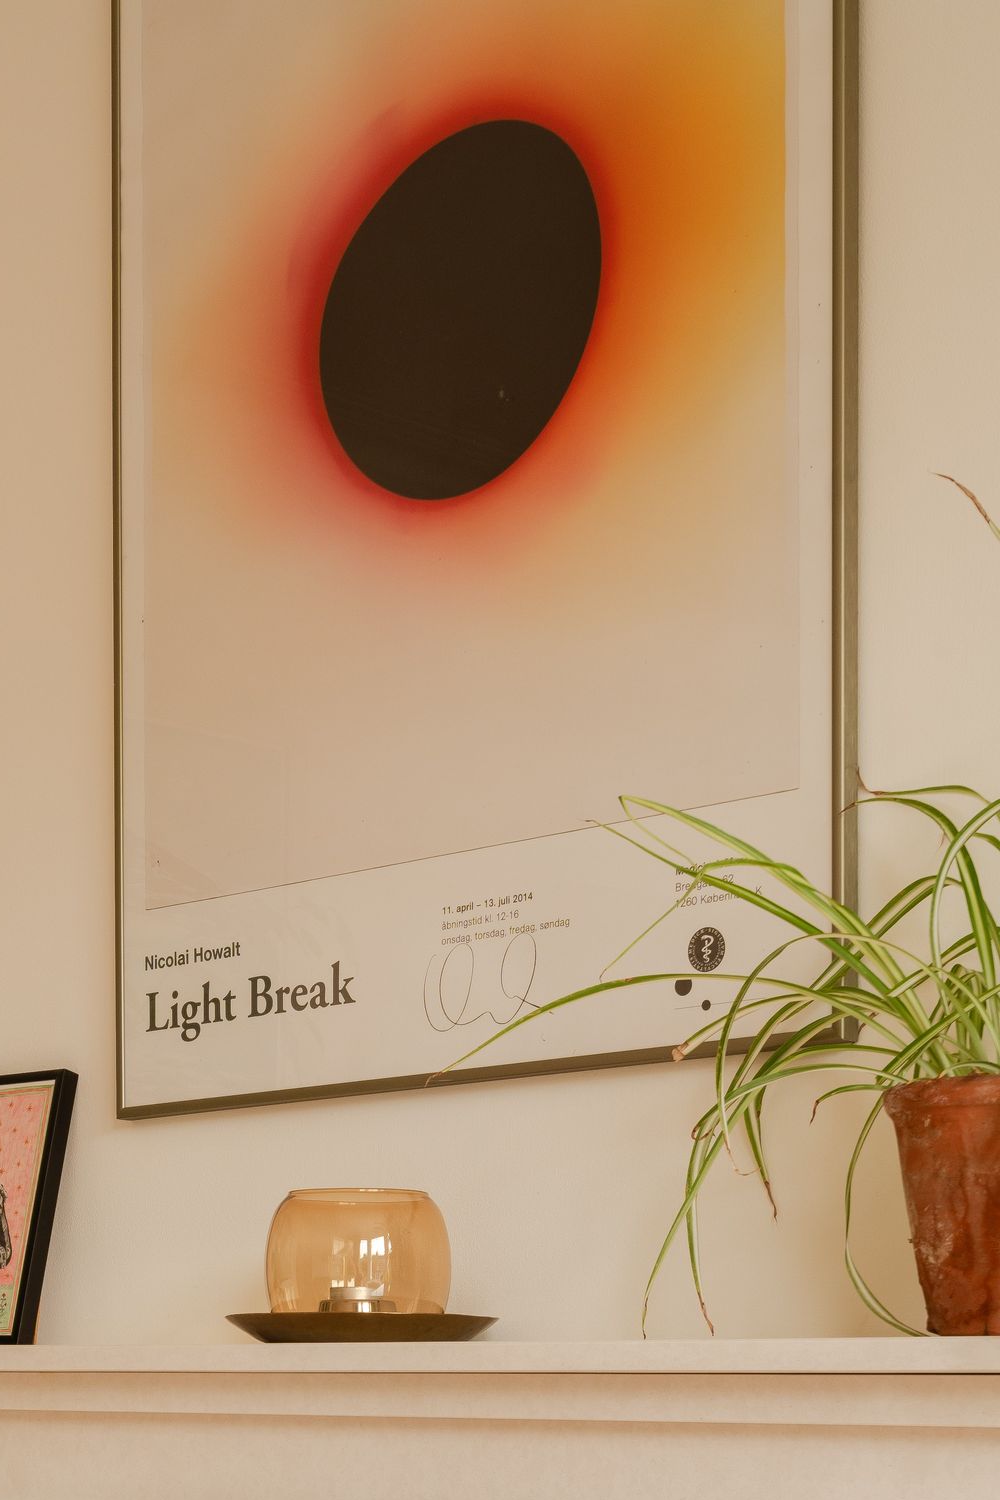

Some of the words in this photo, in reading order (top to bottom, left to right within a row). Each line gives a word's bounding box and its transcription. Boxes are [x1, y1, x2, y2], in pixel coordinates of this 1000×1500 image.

[442, 906, 454, 915] 11.
[456, 902, 474, 914] april
[484, 898, 496, 909] 13.
[498, 896, 511, 908] juli
[513, 892, 533, 904] 2014
[441, 914, 483, 931] åbningstid
[496, 909, 520, 922] 12-16
[441, 934, 473, 946] onsdag,
[475, 927, 507, 942] torsdag,
[509, 922, 537, 936] fredag,
[539, 917, 571, 931] søndag
[144, 949, 190, 971] Nicolai
[193, 941, 241, 963] Howalt
[145, 980, 237, 1042] Light
[247, 960, 357, 1018] Break
